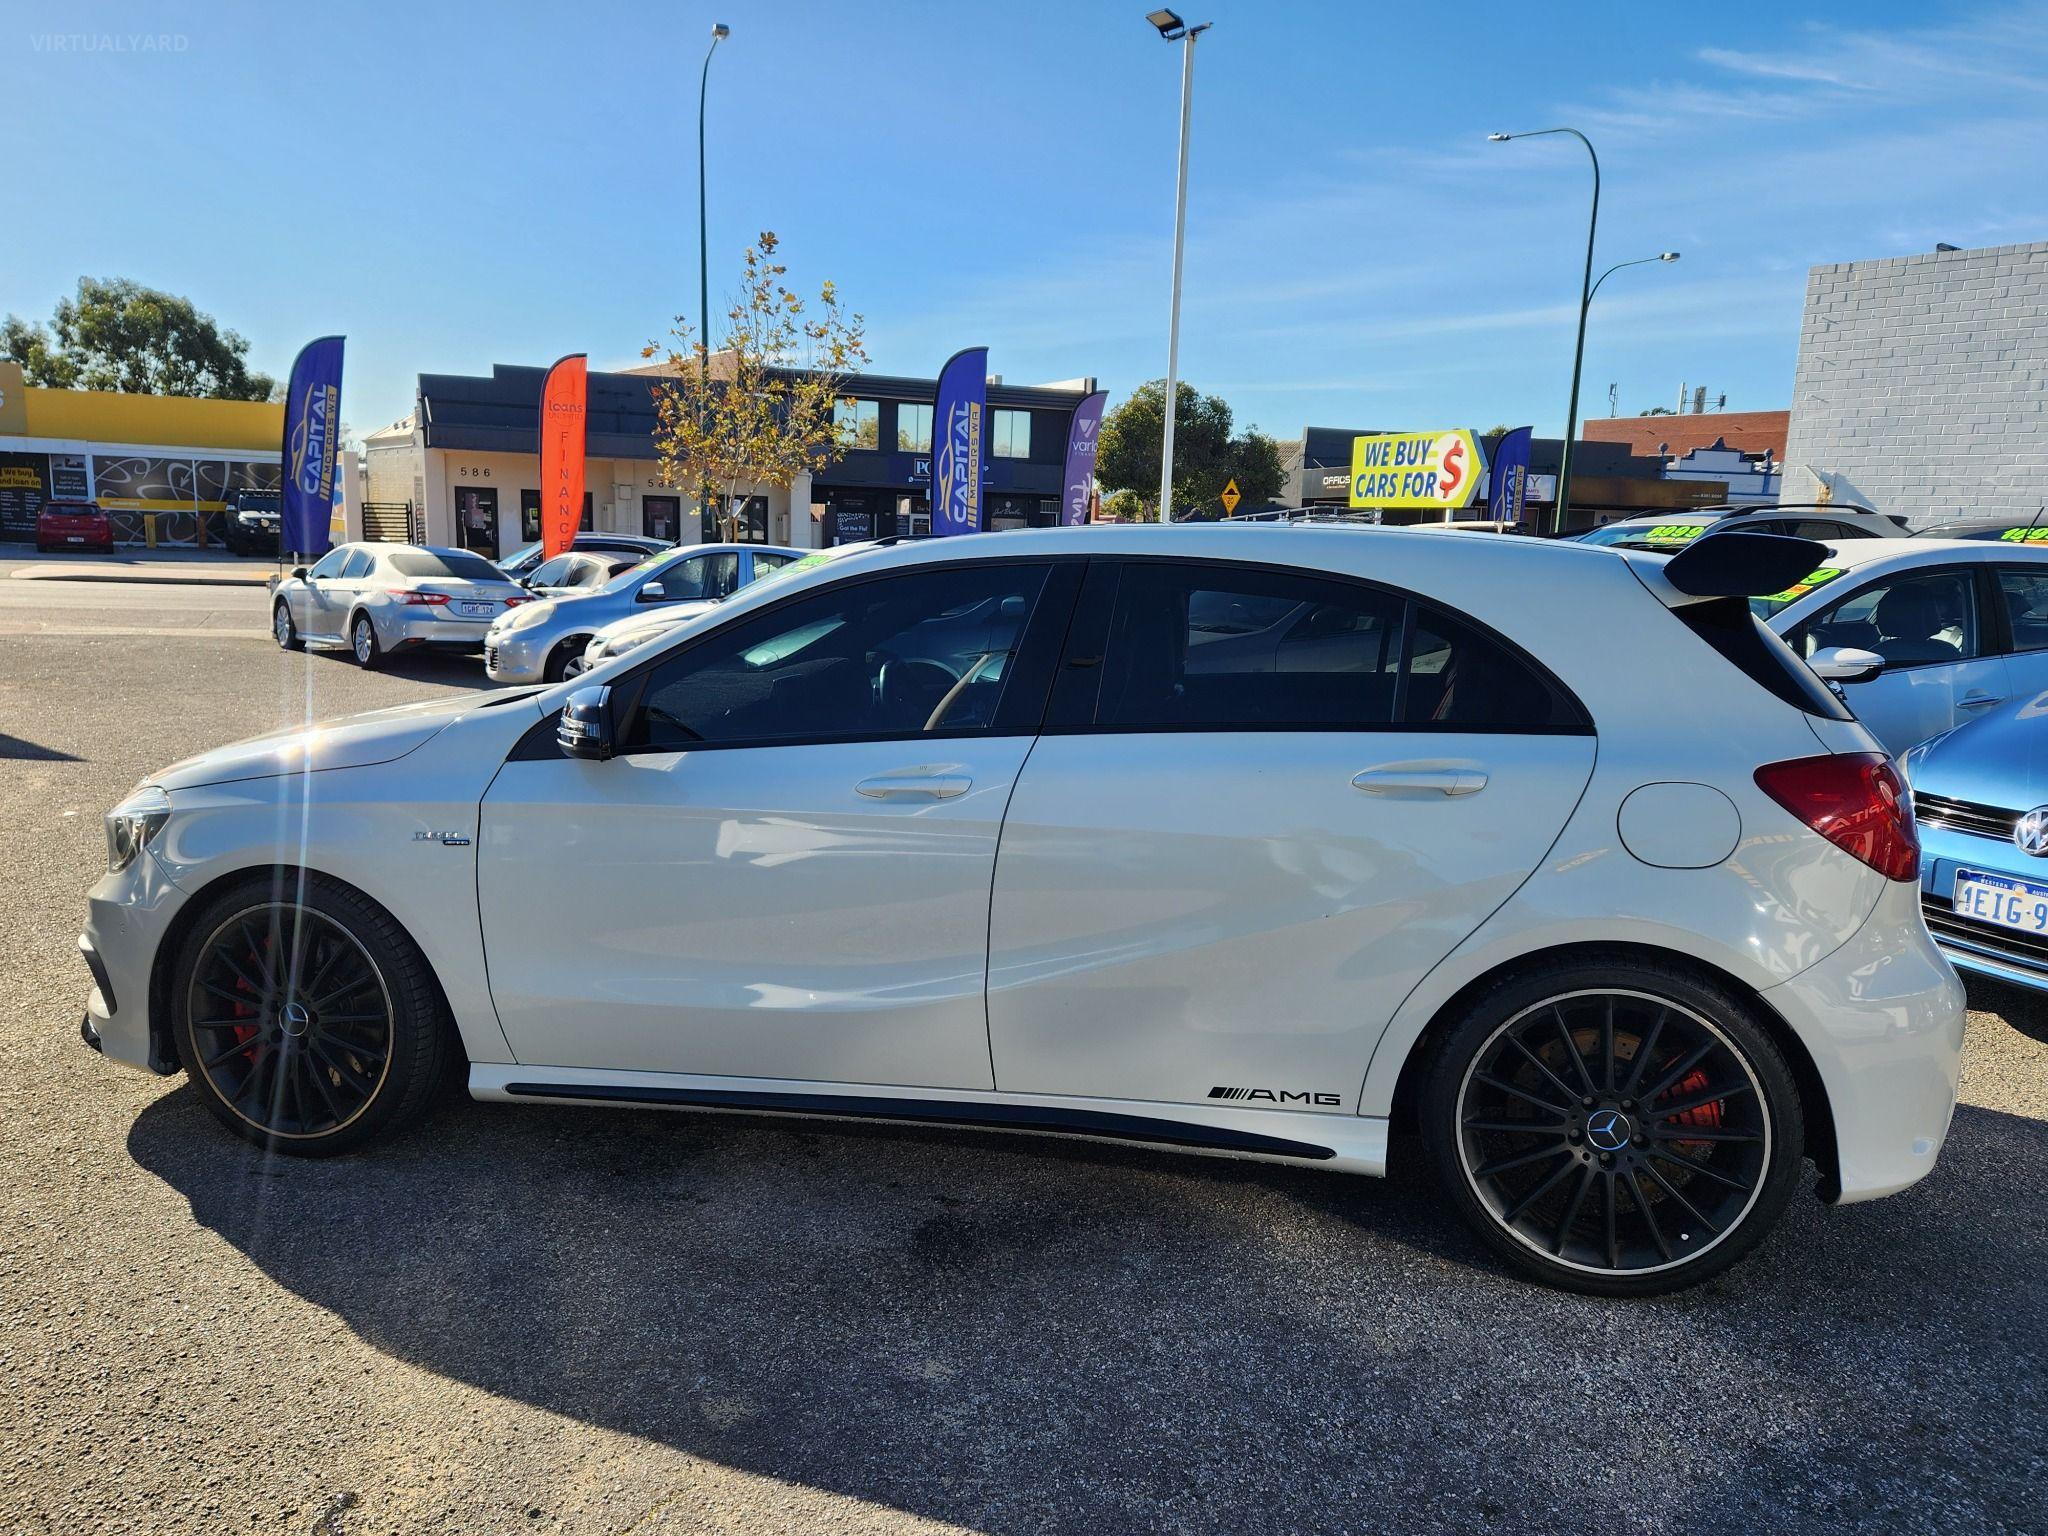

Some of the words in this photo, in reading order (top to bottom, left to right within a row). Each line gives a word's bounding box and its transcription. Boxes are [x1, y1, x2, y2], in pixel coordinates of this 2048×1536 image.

[548, 399, 583, 412] loans
[304, 383, 327, 494] CAPITAL
[324, 418, 335, 474] MOTORS
[953, 401, 971, 524] CAPITAL
[1365, 441, 1391, 467] WE
[1394, 439, 1433, 466] BUY
[460, 466, 491, 478] 586
[559, 431, 569, 550] FINANCE
[970, 438, 979, 499] MOTORS
[1355, 472, 1398, 498] CARS
[1401, 471, 1438, 498] FOR
[1439, 440, 1464, 499] $
[1505, 464, 1517, 521] PITAL
[1980, 879, 2008, 889] WESTERN
[1246, 1088, 1341, 1106] AMG
